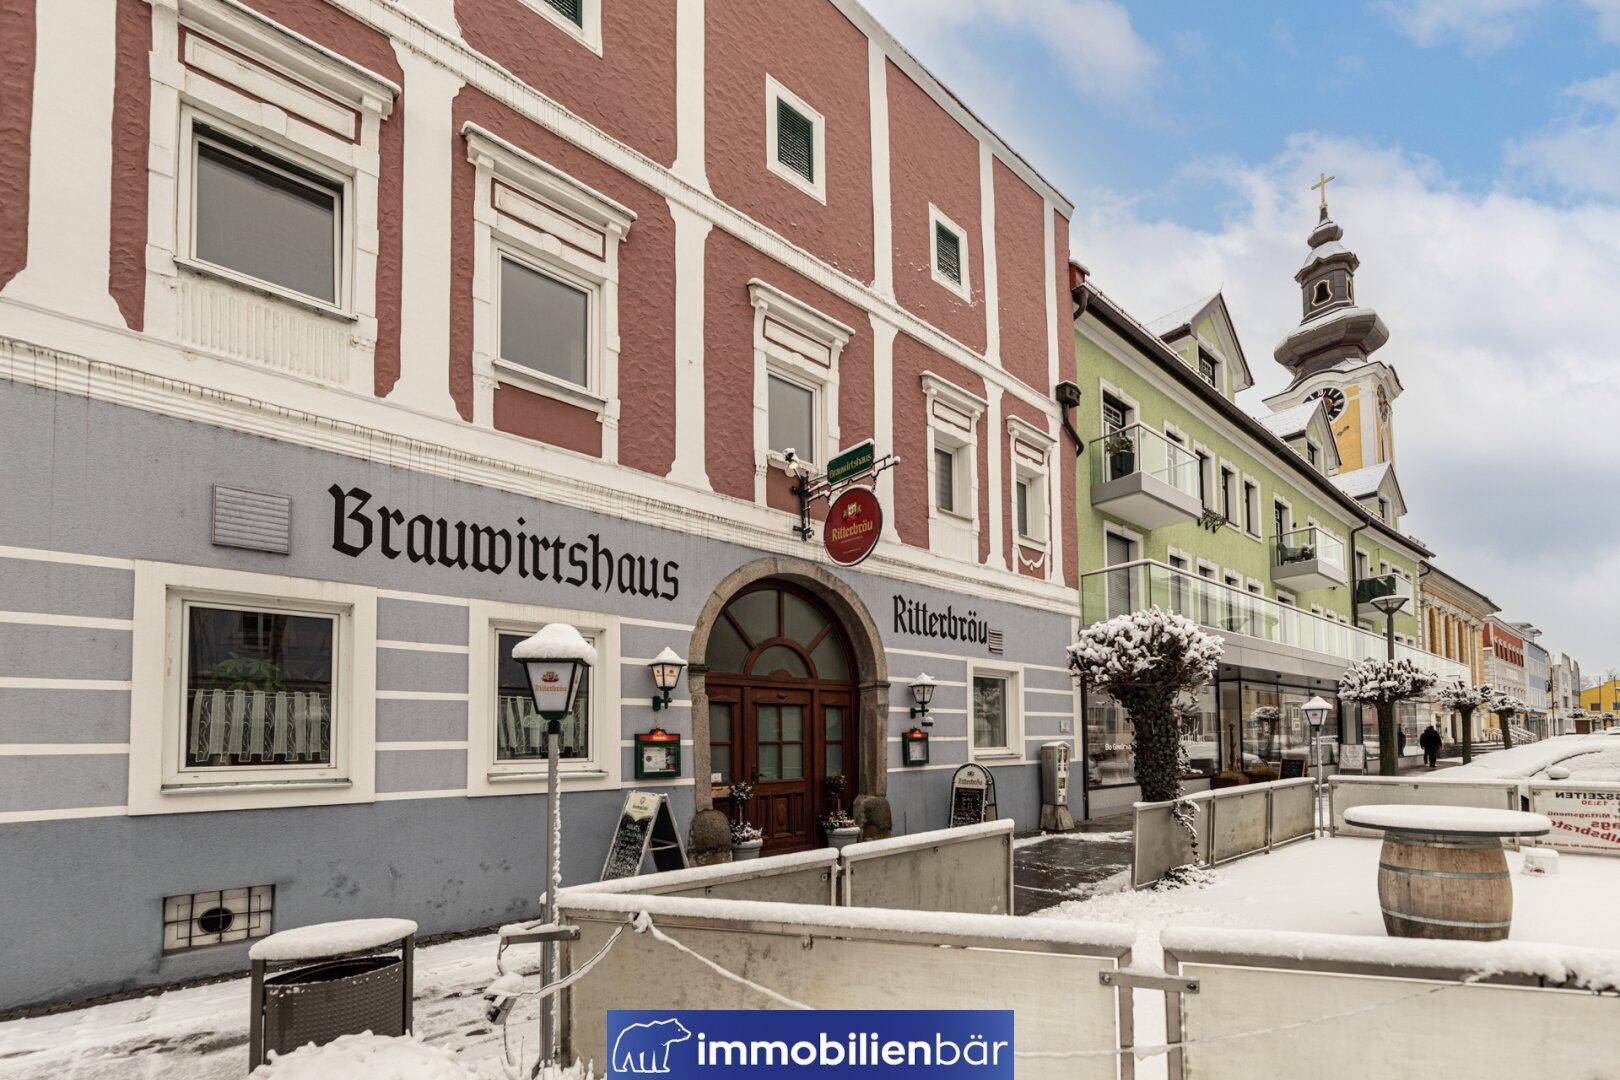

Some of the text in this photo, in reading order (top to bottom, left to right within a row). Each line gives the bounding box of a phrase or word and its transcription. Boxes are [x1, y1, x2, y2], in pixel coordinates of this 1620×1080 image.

[829, 453, 872, 478] Brauwirtshaus
[328, 483, 680, 601] Brauwirtshaus
[831, 519, 874, 543] Ritterbräu
[893, 594, 988, 645] Ritterbräu
